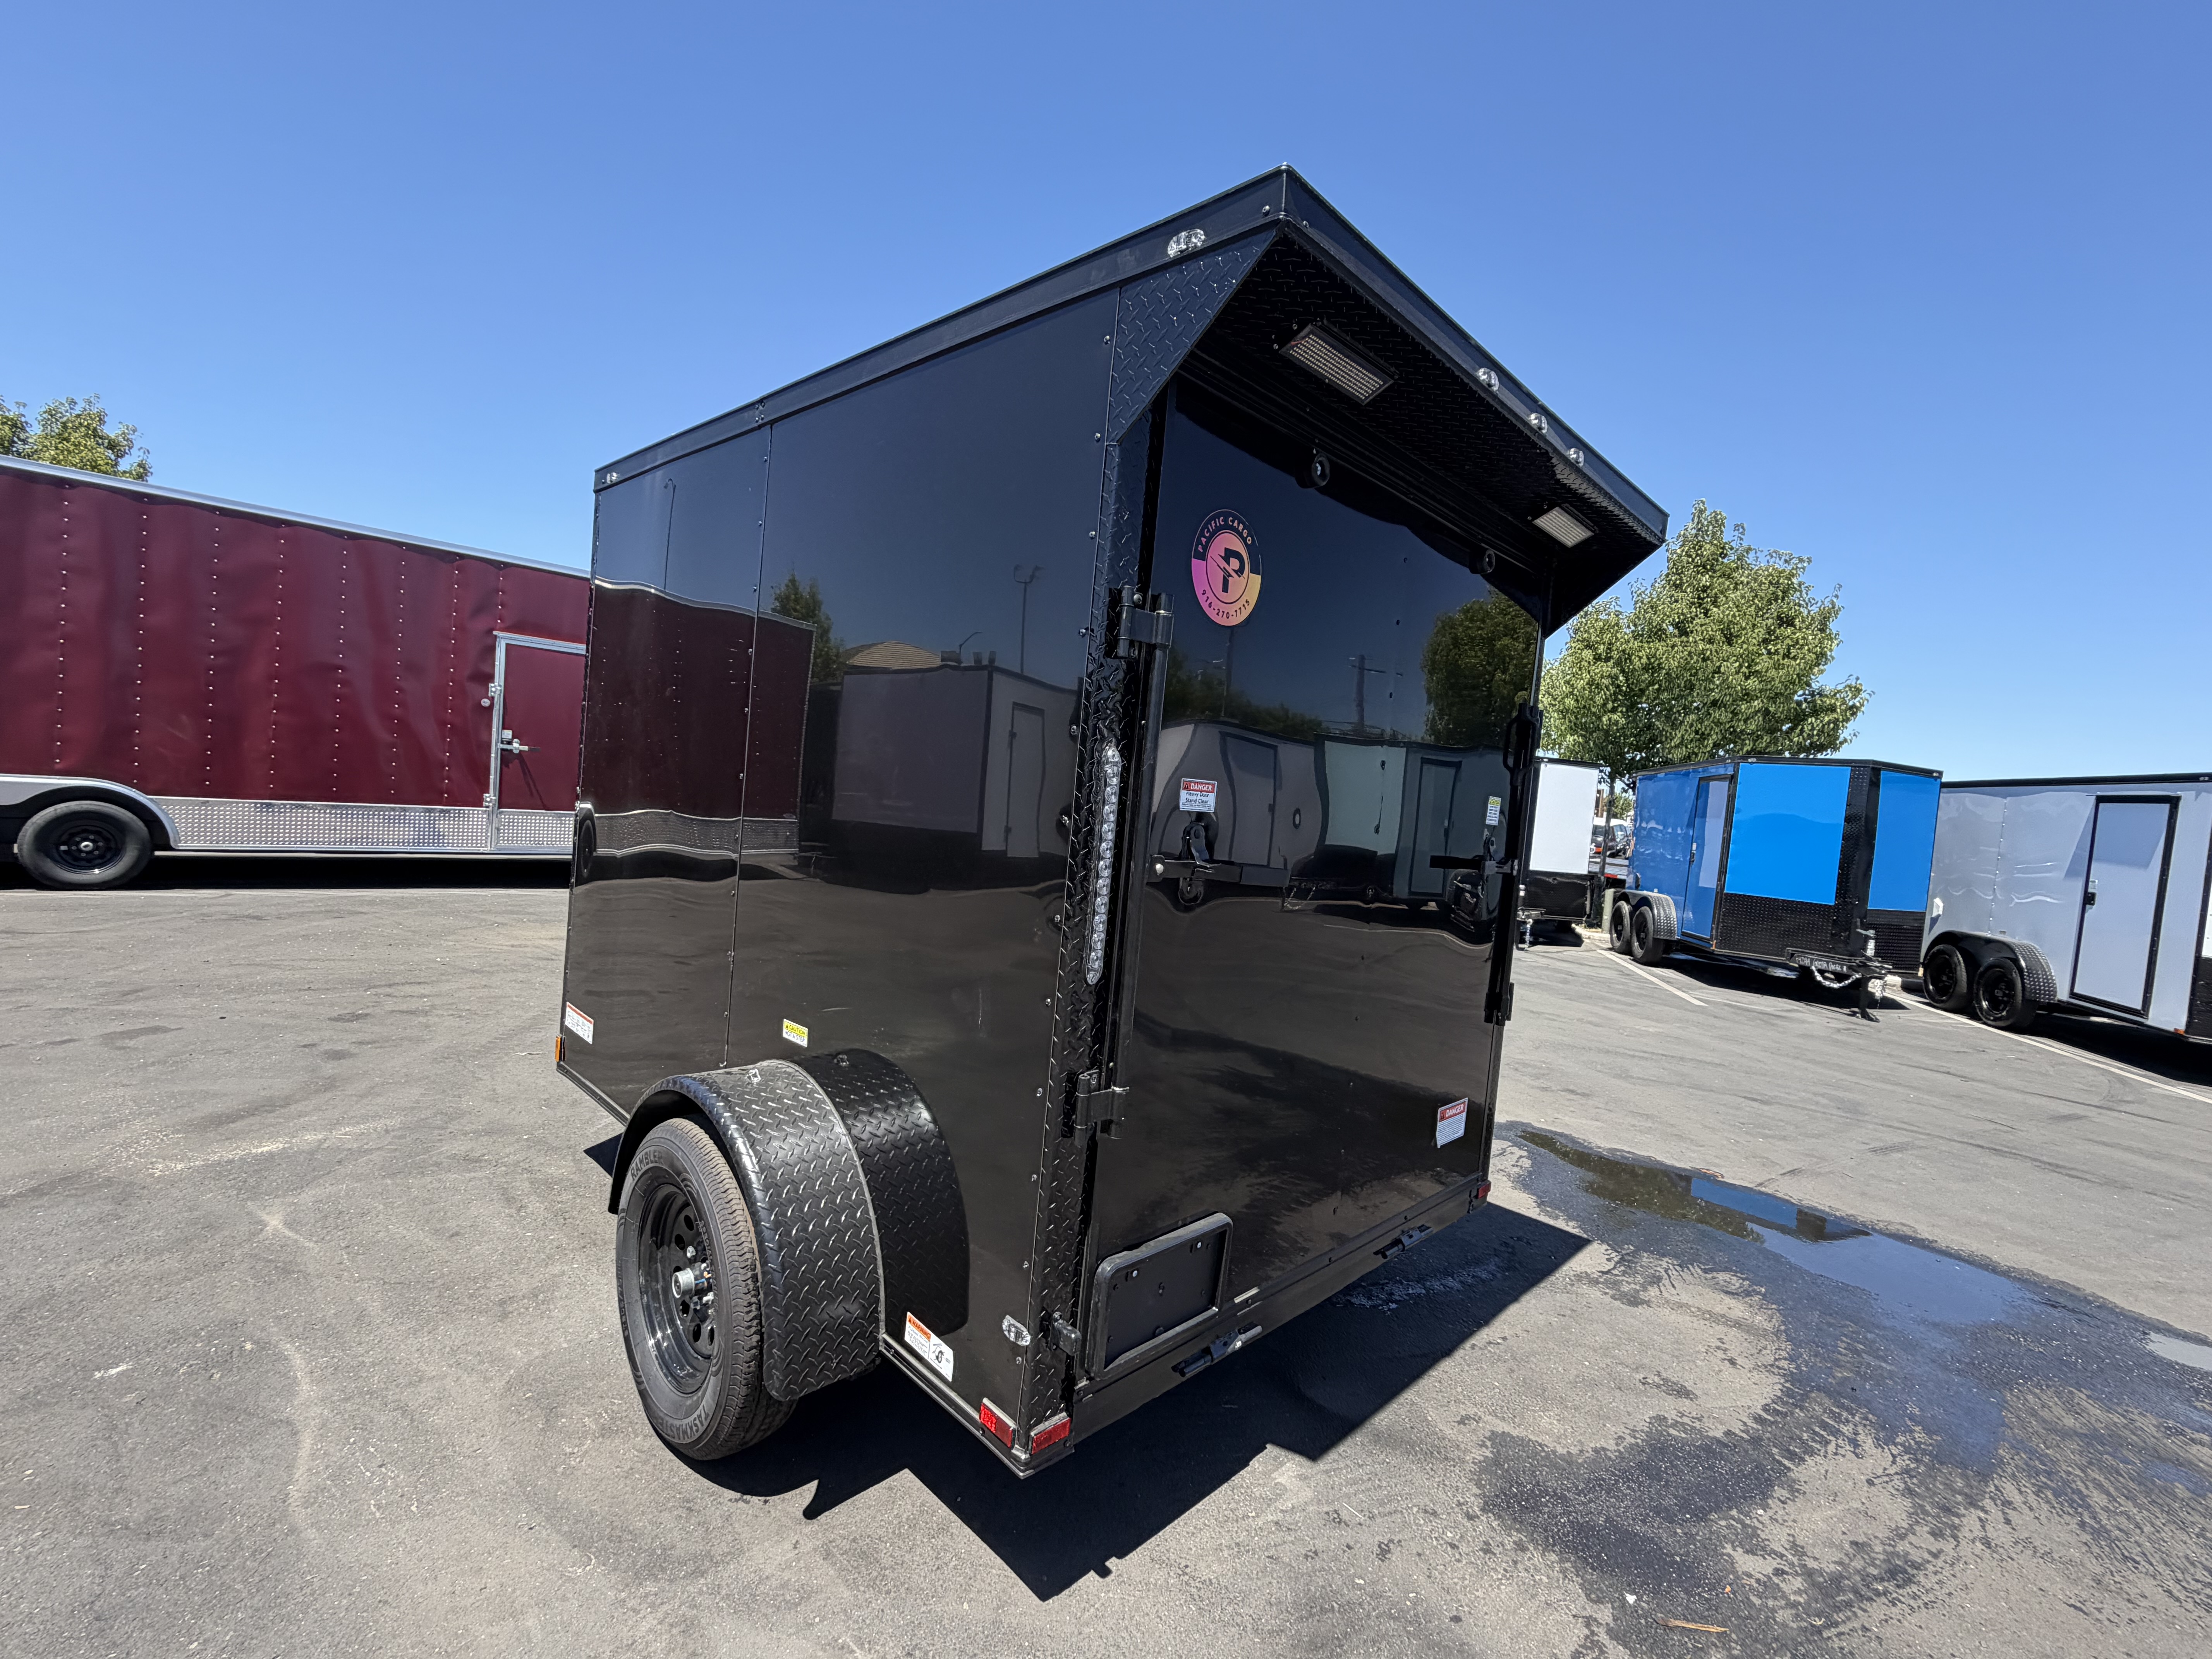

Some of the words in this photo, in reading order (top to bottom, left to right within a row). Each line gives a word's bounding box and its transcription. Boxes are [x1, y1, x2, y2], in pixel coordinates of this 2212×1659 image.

[1198, 516, 1224, 553] PACIFIC
[1228, 517, 1252, 544] CARGO
[1201, 589, 1250, 619] 916-270-7715
[1190, 783, 1212, 792] DANGER
[1446, 1104, 1464, 1118] DANGER
[630, 1149, 663, 1181] RAMBLER
[912, 1318, 931, 1340] WARNING
